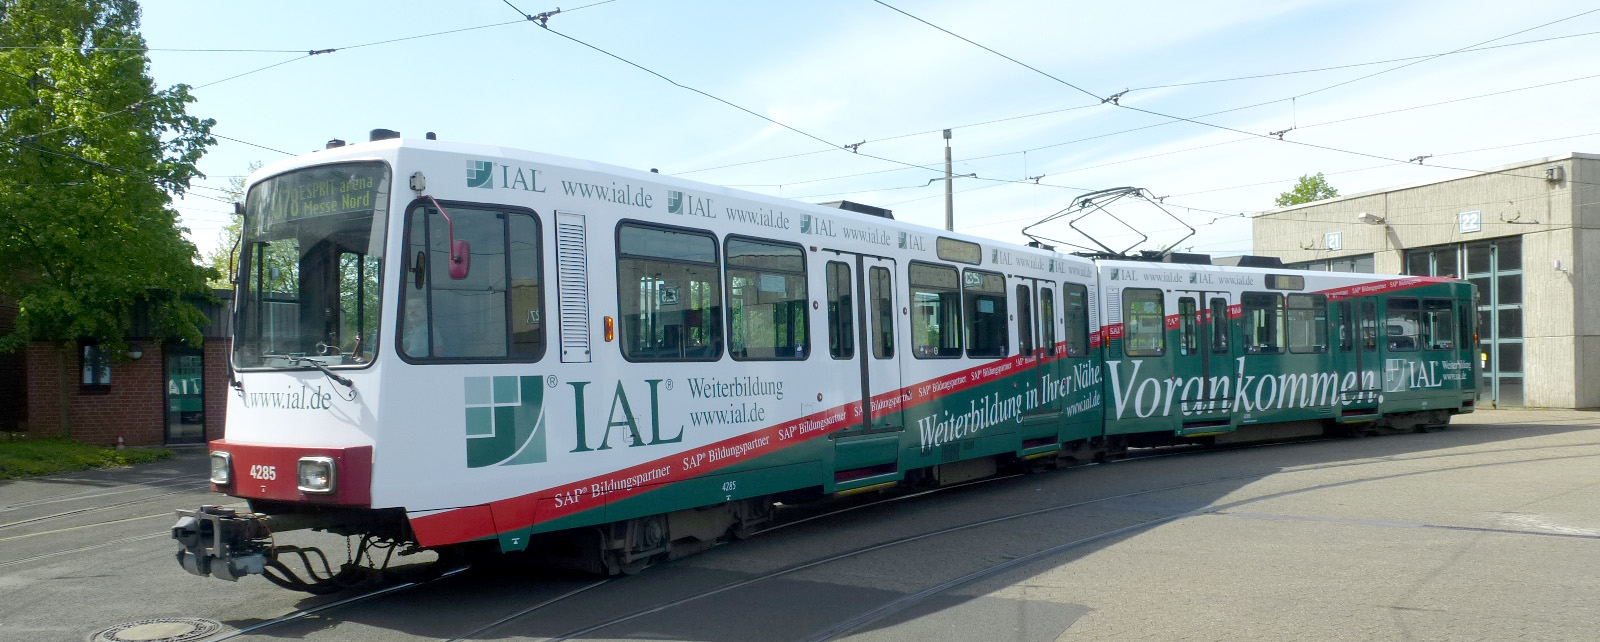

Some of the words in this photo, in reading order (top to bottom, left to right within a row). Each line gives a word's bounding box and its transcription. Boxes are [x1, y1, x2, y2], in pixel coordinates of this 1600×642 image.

[300, 181, 334, 199] ESPRIT
[341, 177, 373, 192] arena
[304, 201, 337, 216] Messe
[342, 192, 370, 209] Nord
[561, 181, 653, 209] www.ial.de
[726, 207, 790, 230] www.ial.de
[842, 227, 891, 246] www.ial.de
[1462, 213, 1478, 230] 22
[1328, 234, 1339, 249] 21
[1143, 272, 1183, 283] www.ial.de
[249, 385, 332, 410] www.ial.de
[687, 376, 784, 400] Weiterbildung
[1106, 356, 1384, 421] Vorankommen.
[690, 402, 765, 427] www.ial.de
[917, 392, 1024, 453] Weiterbildung
[1025, 382, 1039, 411] in
[1041, 373, 1072, 405] Ihrer
[1073, 359, 1103, 392] Nähe.
[1066, 390, 1100, 418] www.ial.de
[590, 465, 671, 499] Bildungspartner
[708, 434, 770, 463] Bildungspartner
[799, 410, 847, 435] Bildungspartner
[249, 465, 277, 480] 4285
[722, 480, 736, 492] 4285
